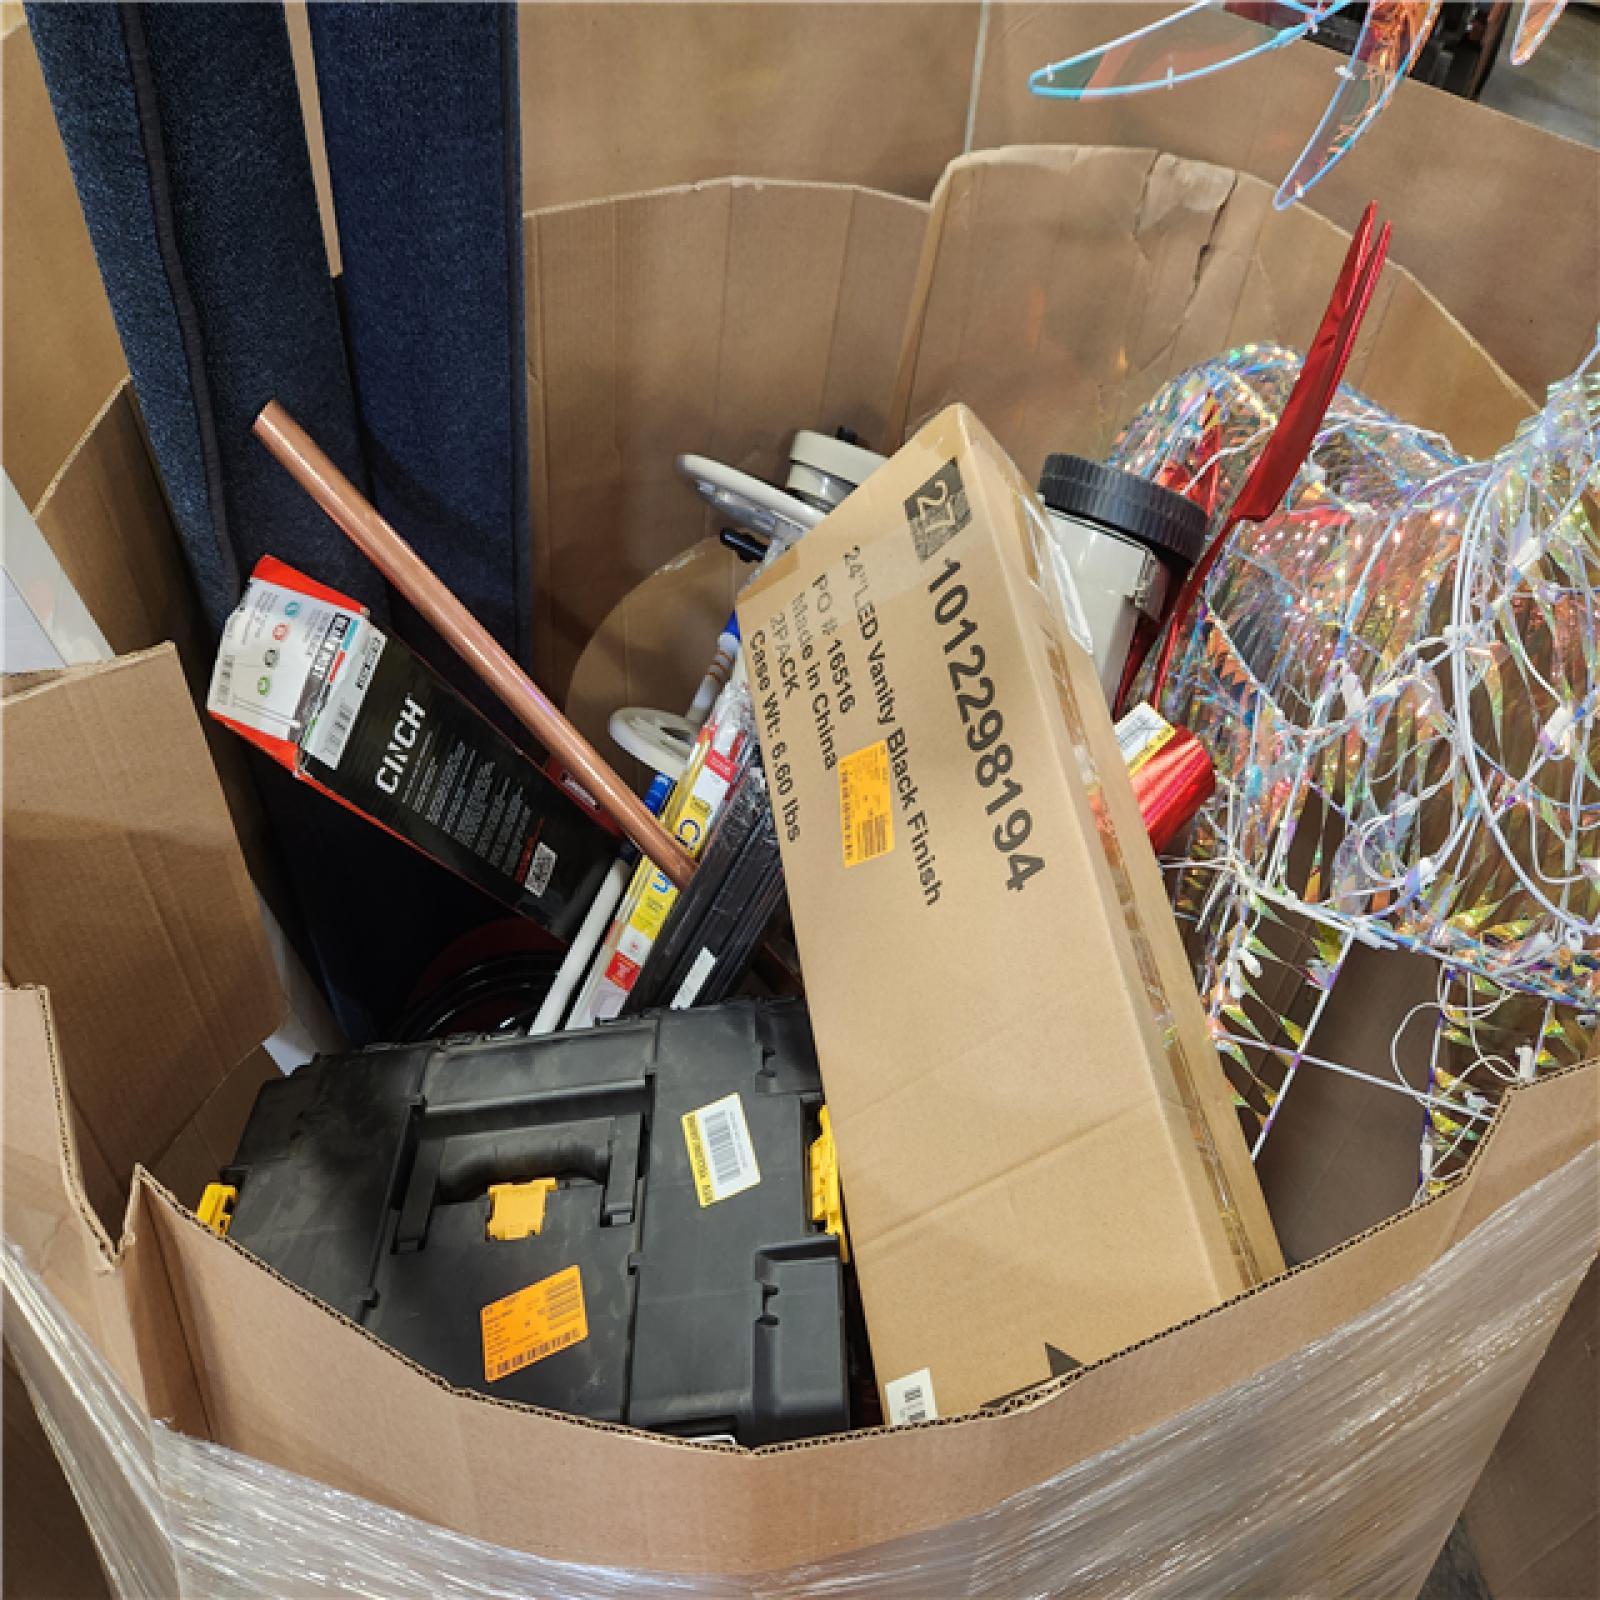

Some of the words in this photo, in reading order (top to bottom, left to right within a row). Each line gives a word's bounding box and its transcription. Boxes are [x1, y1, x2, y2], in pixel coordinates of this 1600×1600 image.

[916, 479, 957, 533] 27
[804, 660, 821, 691] in
[811, 571, 833, 614] PO
[826, 639, 856, 714] 16516
[375, 694, 426, 795] CINCH
[749, 629, 771, 691] Case
[782, 797, 801, 842] lbs
[811, 691, 837, 771] China
[867, 638, 896, 725] Vanity
[886, 726, 919, 811] Black
[906, 809, 943, 907] Finish
[927, 557, 1046, 892] 1012298194
